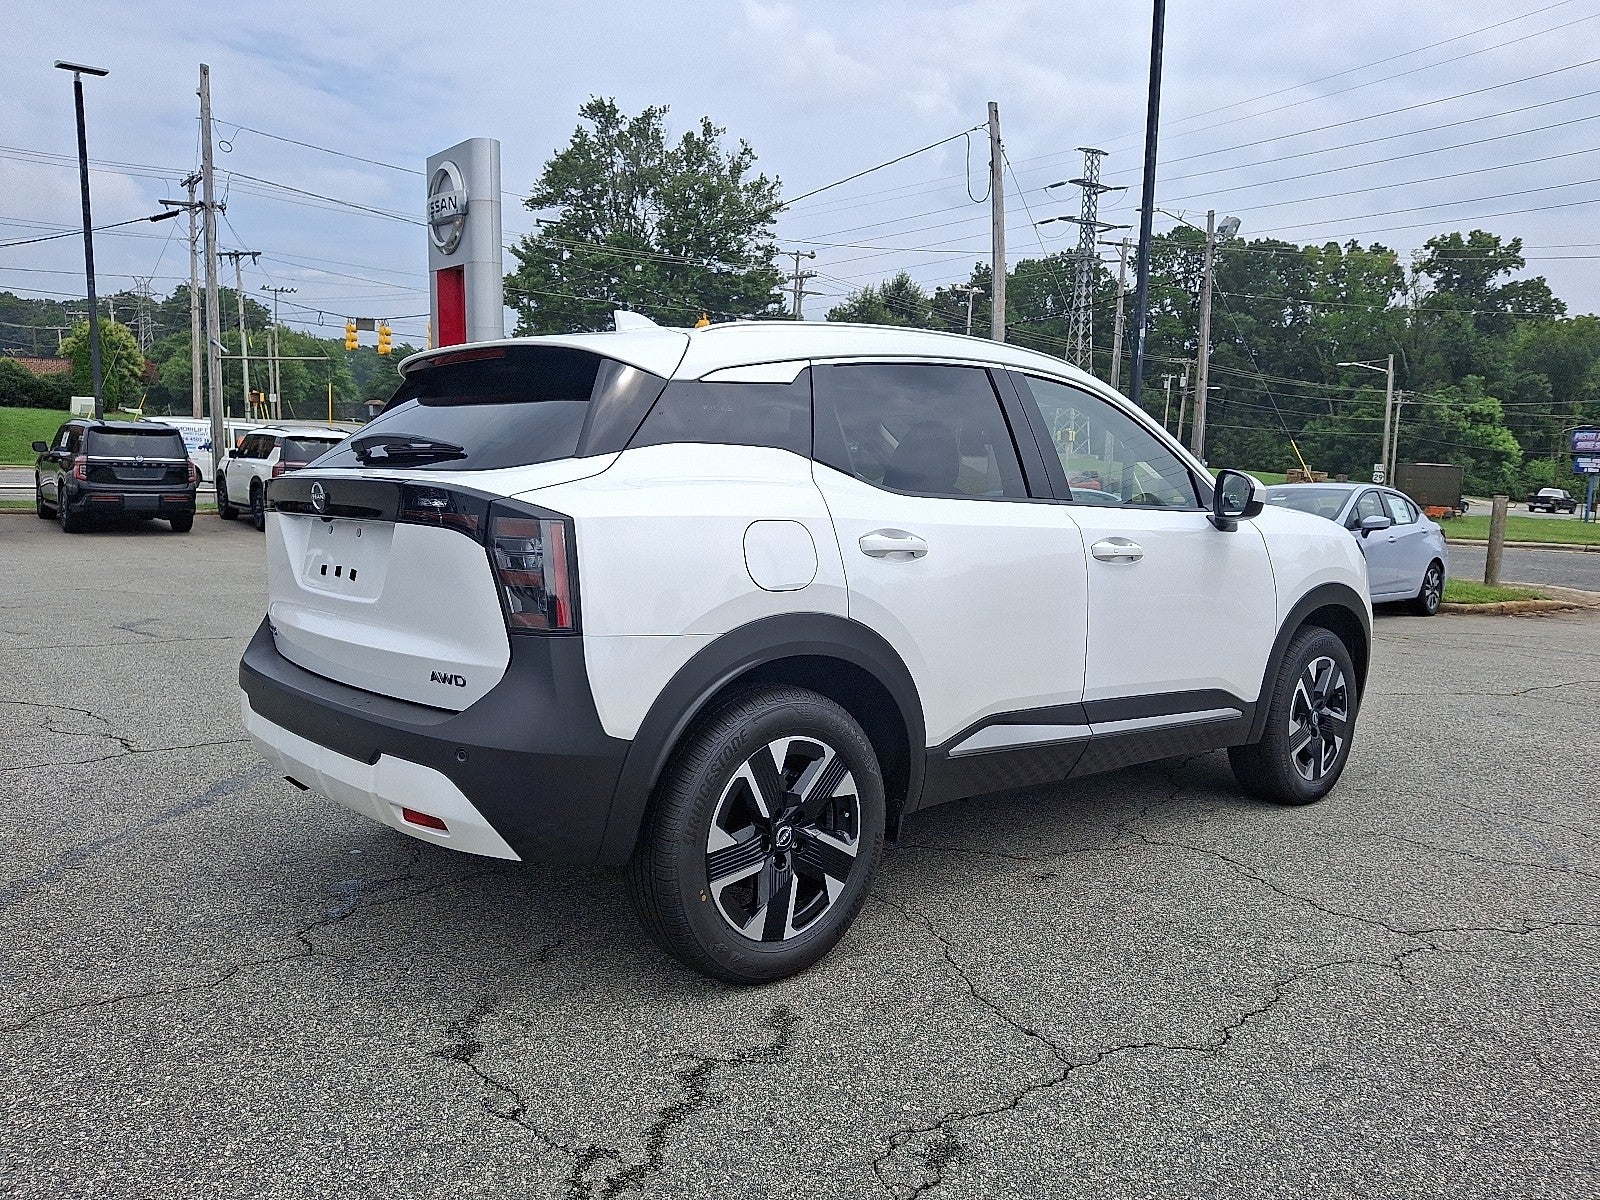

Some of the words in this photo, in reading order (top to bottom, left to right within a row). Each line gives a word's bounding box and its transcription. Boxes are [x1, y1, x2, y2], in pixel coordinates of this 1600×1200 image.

[1373, 473, 1383, 481] 29
[430, 670, 467, 688] AWD
[683, 728, 749, 846] BRIDGESTONE
